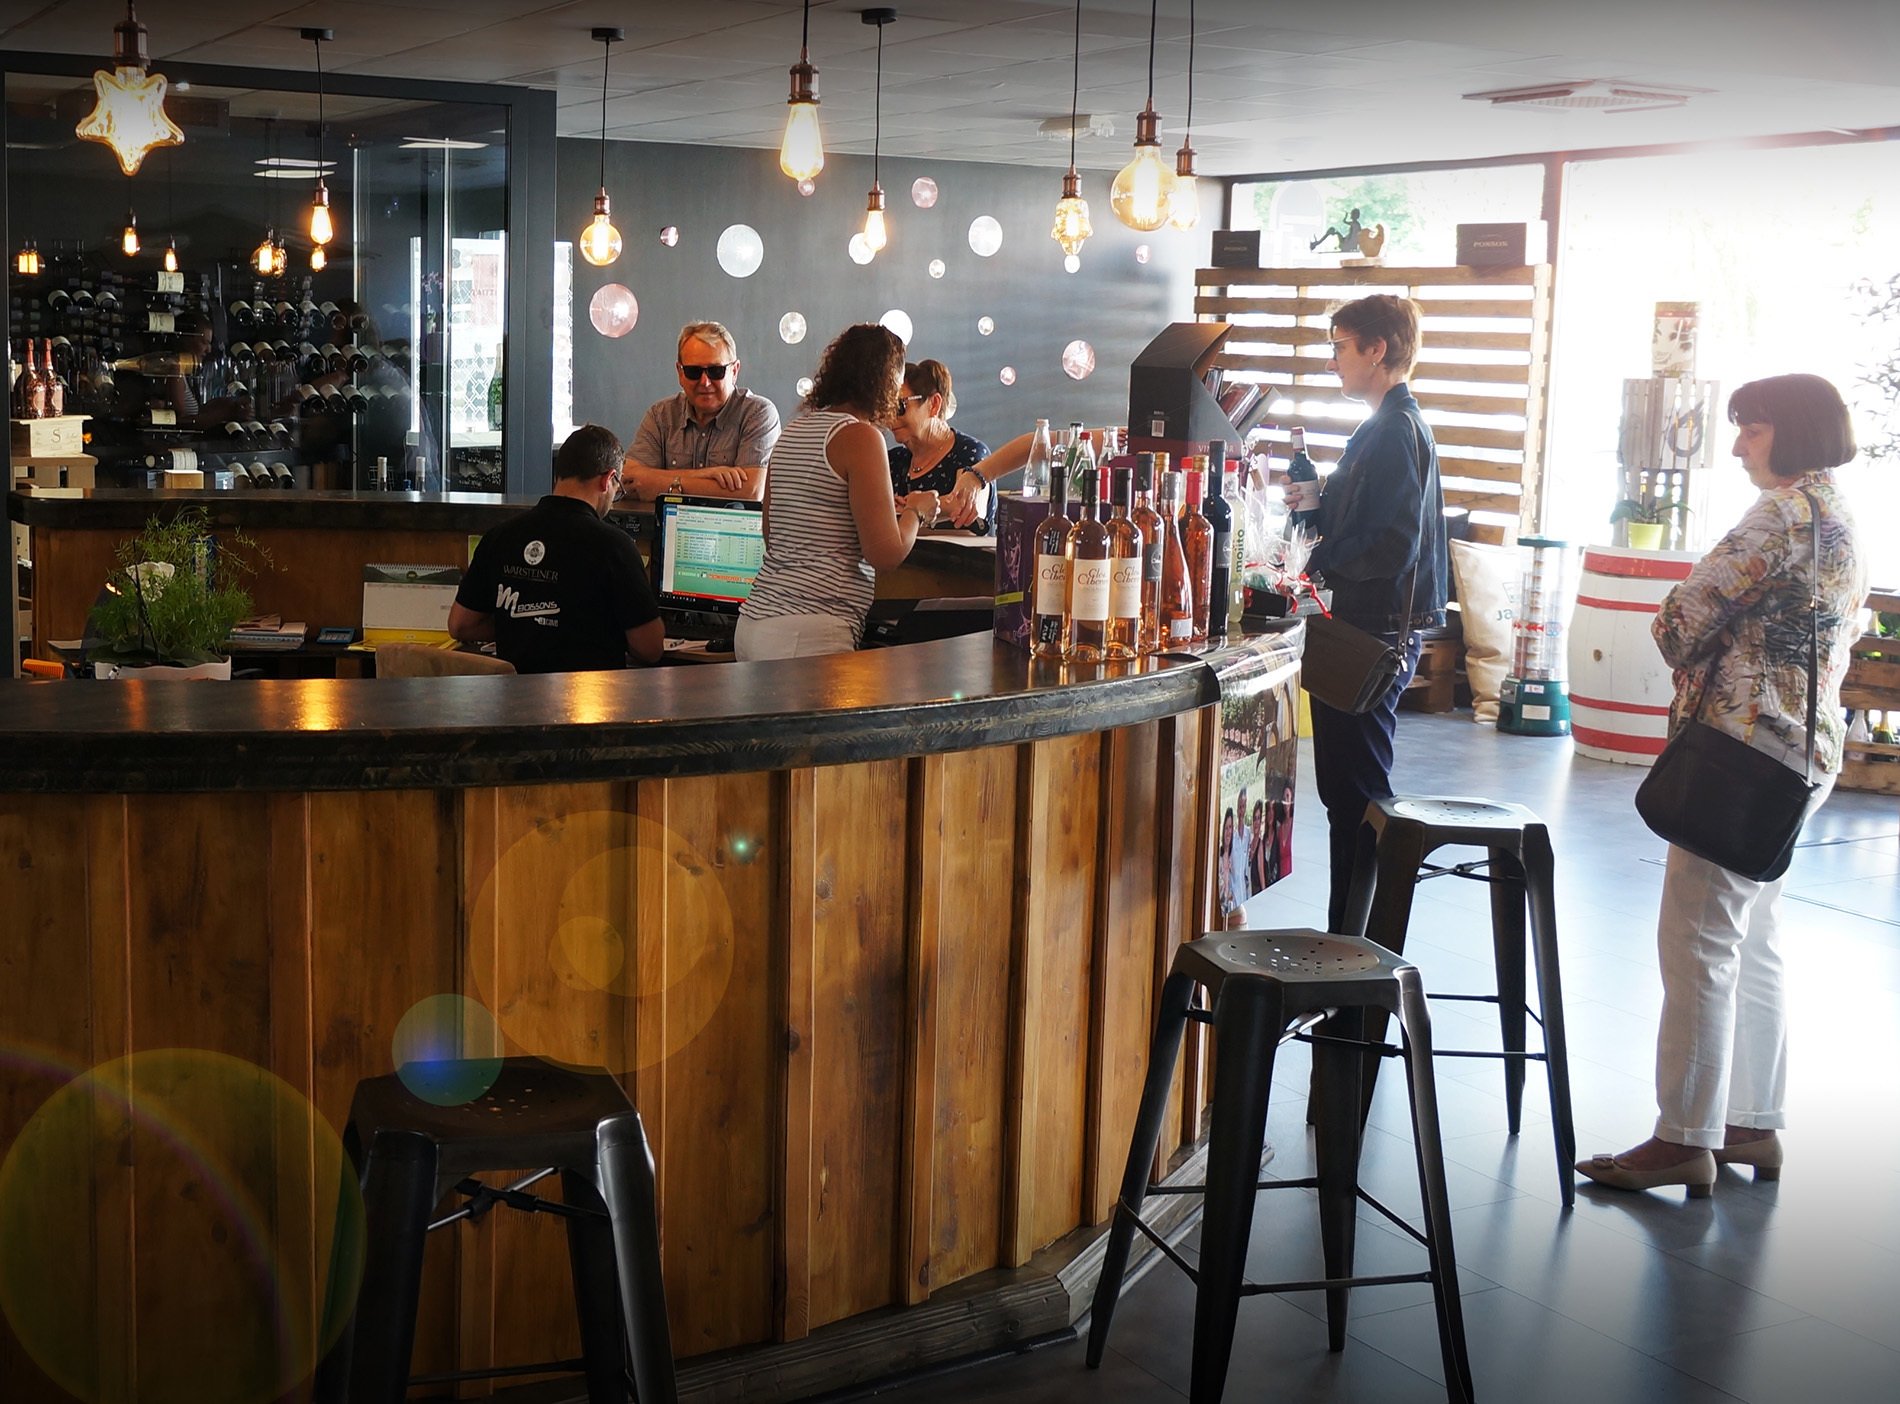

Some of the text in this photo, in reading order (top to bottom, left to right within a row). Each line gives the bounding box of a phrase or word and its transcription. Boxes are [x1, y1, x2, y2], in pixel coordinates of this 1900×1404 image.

[1235, 529, 1245, 573] mojito
[503, 564, 559, 581] WARSTEINER
[517, 601, 558, 612] BOISSONS
